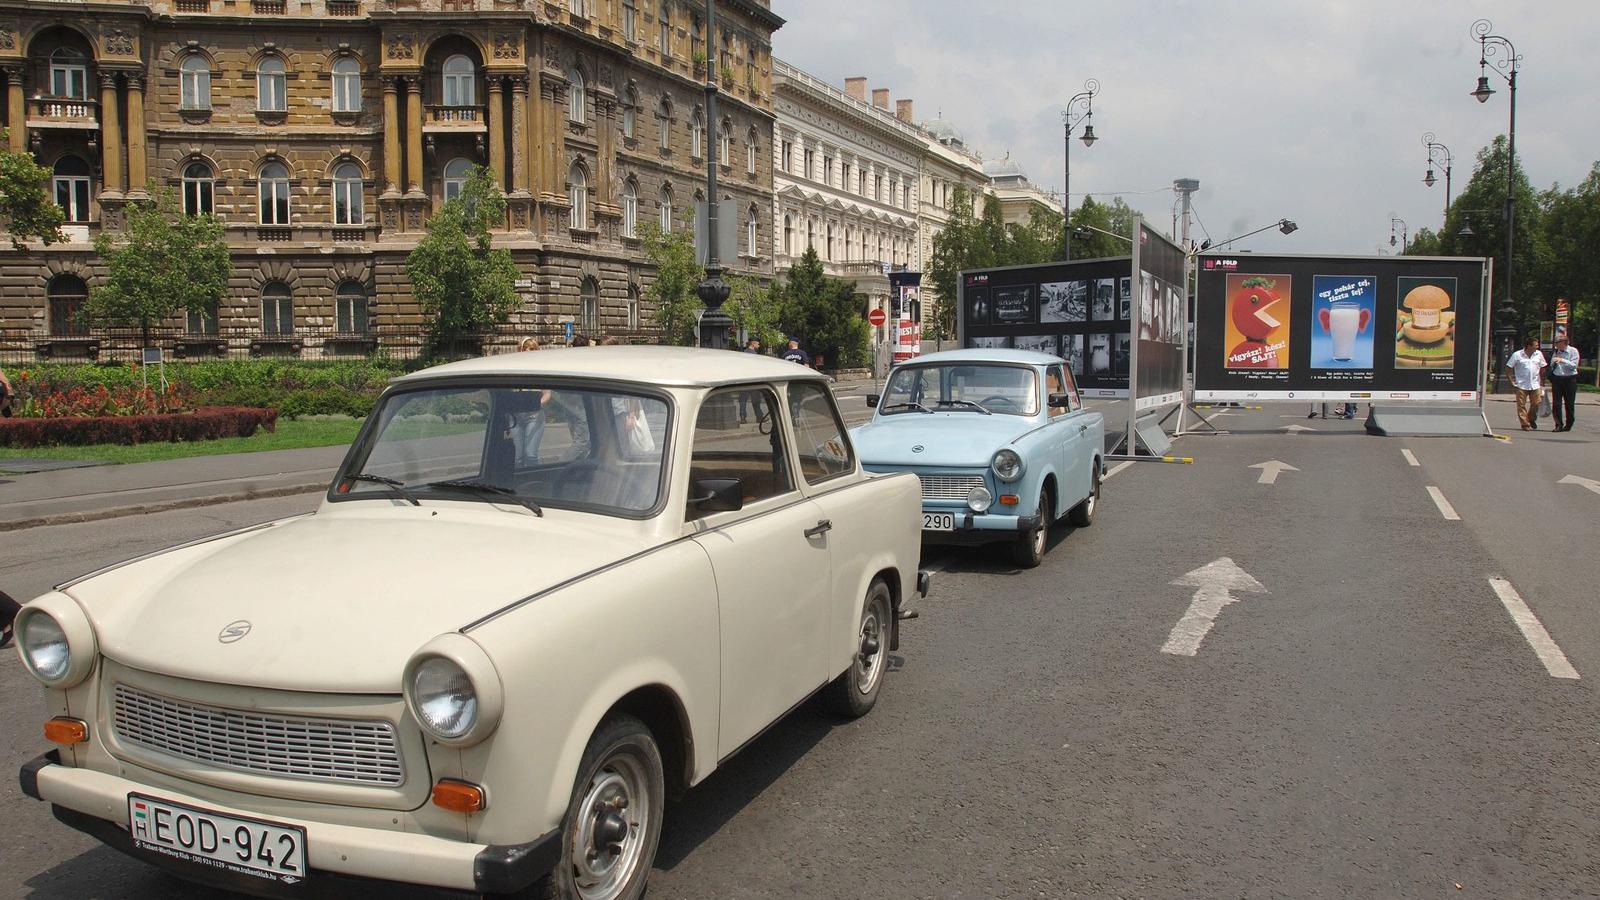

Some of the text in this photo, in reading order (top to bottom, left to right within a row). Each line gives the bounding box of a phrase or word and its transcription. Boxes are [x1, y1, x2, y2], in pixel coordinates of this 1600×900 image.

[1251, 351, 1277, 364] SAJT!
[924, 514, 951, 529] 290
[135, 820, 147, 838] H
[154, 807, 297, 872] EOD-942
